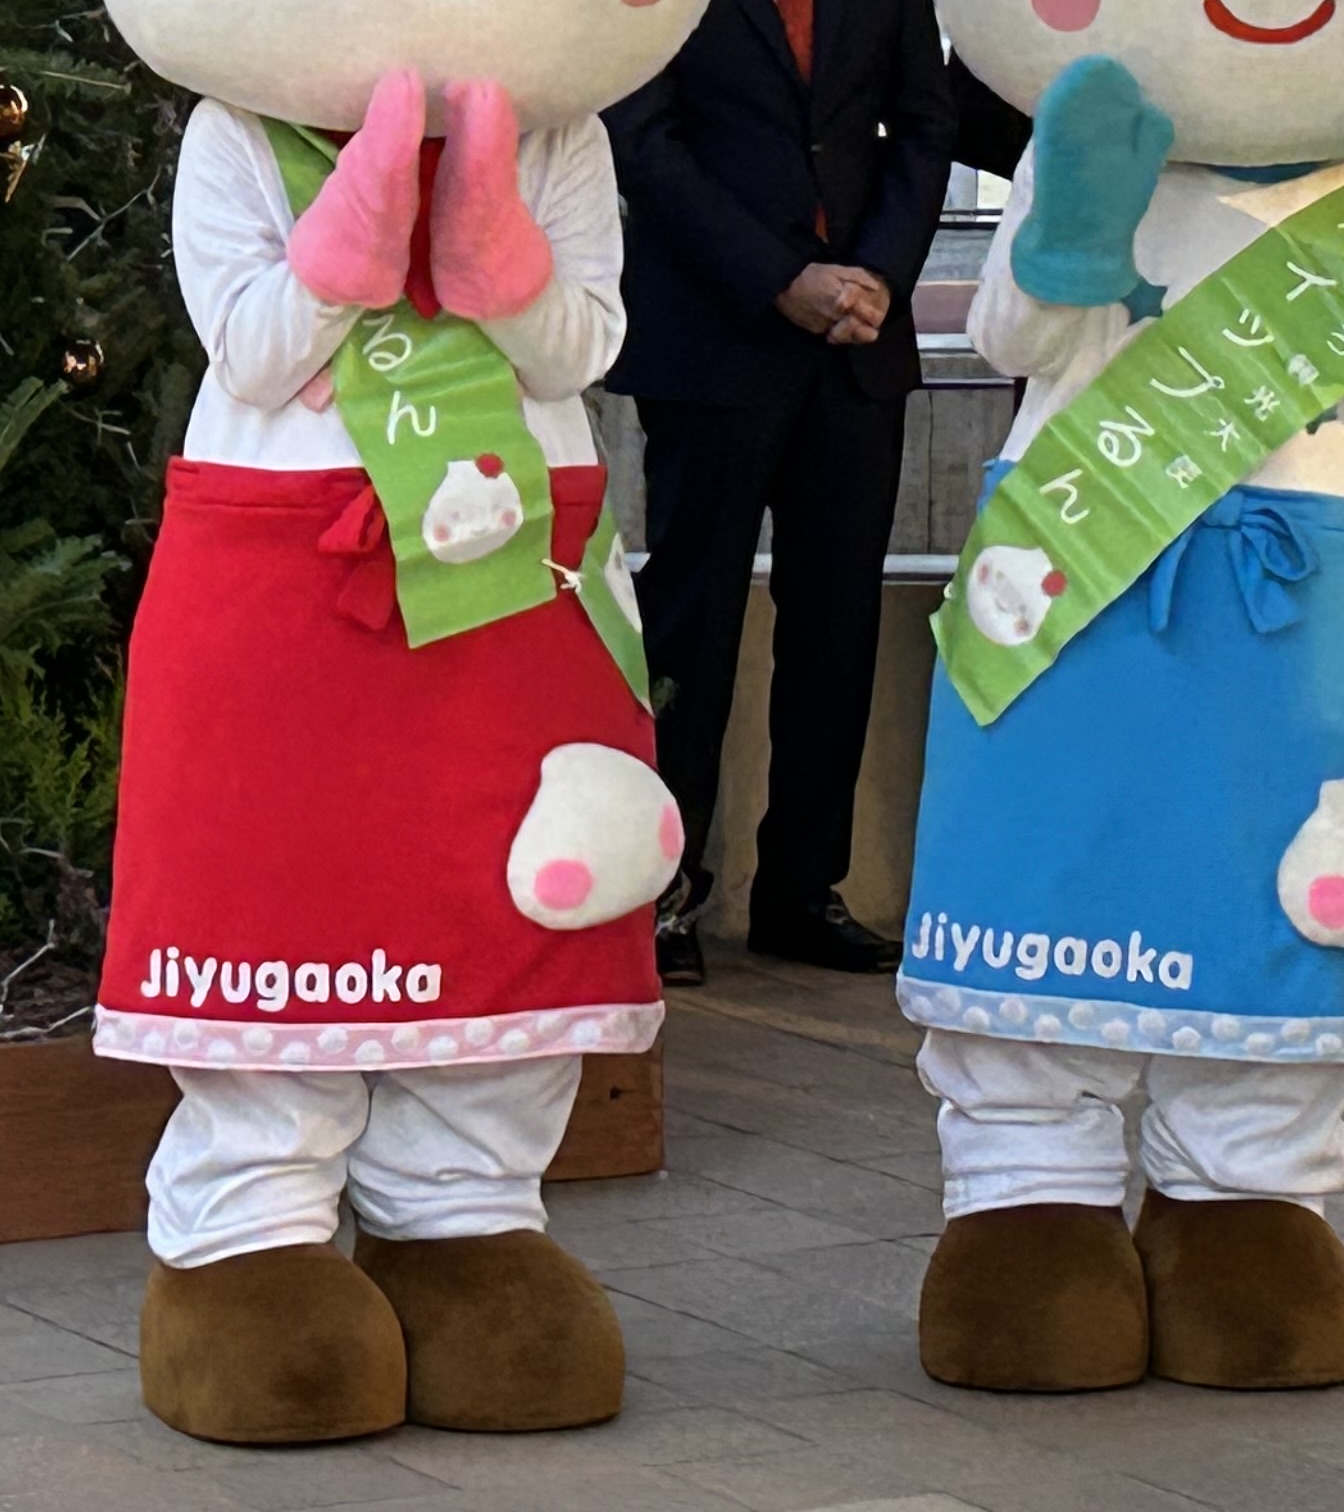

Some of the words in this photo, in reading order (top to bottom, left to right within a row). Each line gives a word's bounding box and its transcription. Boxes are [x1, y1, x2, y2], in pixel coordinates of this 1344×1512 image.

[361, 313, 438, 446] るん
[140, 946, 442, 1013] Jiyugaoka
[911, 911, 1194, 991] Jiyugaoka
